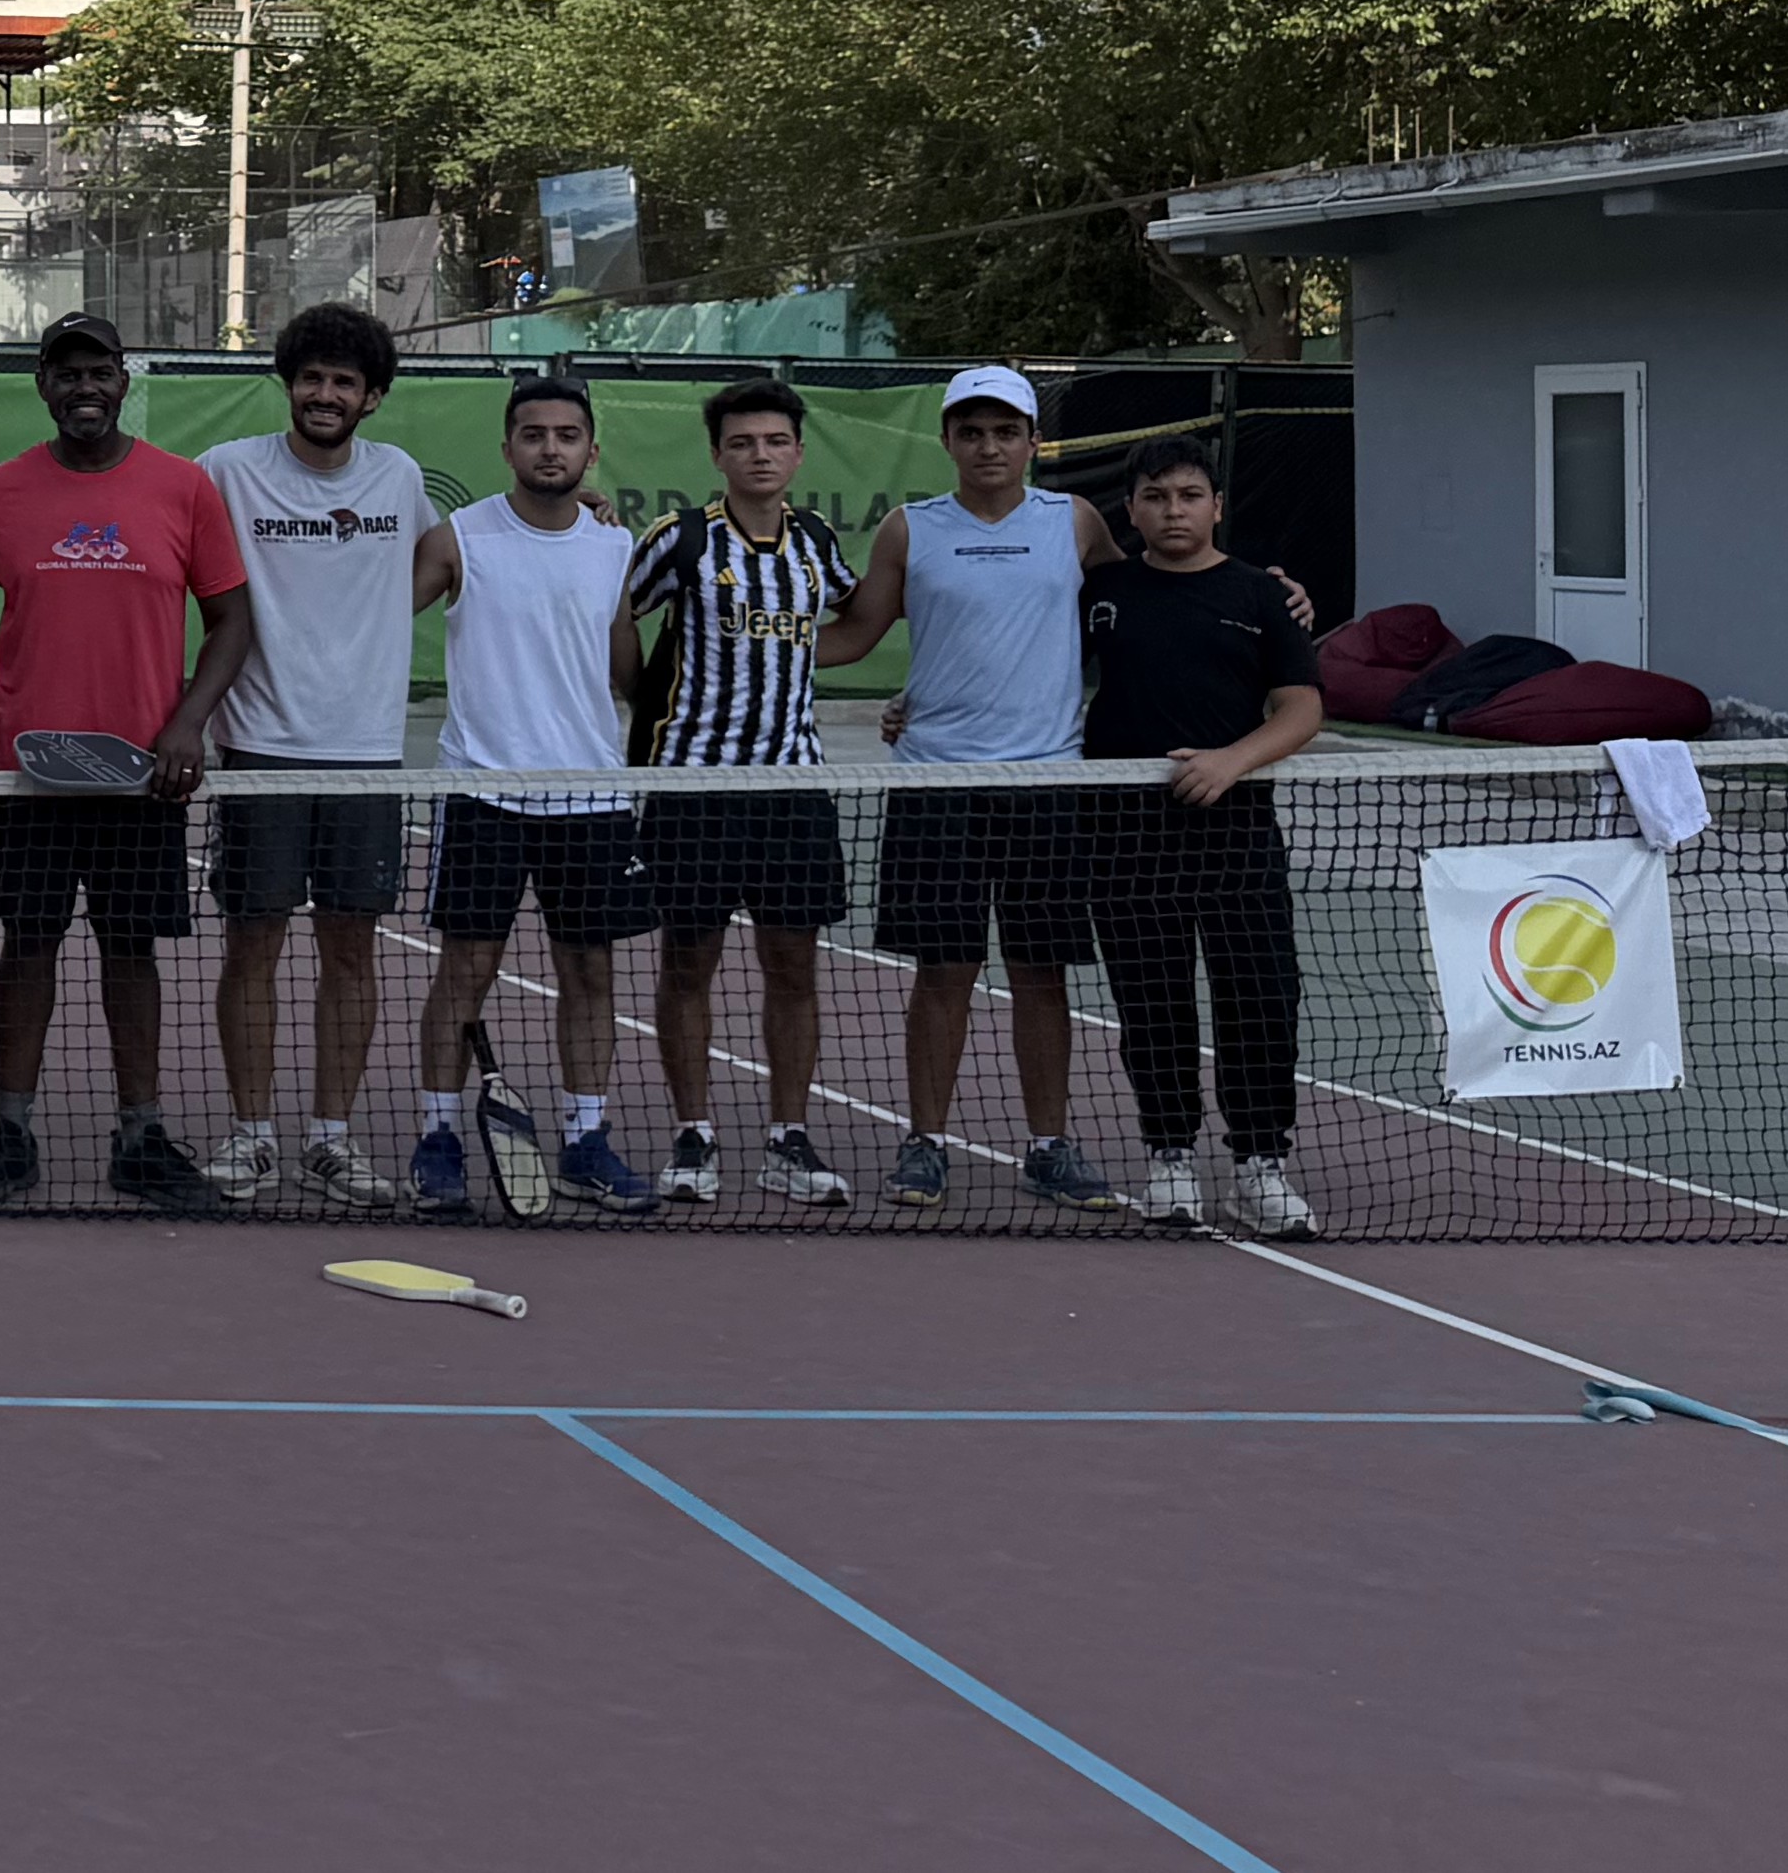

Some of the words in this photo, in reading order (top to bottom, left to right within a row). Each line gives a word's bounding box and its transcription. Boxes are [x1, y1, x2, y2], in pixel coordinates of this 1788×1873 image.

[253, 517, 332, 537] SPARTAN
[362, 514, 399, 534] RACE
[718, 601, 817, 647] Jeep
[1503, 1040, 1622, 1064] TENNIS.AZ
